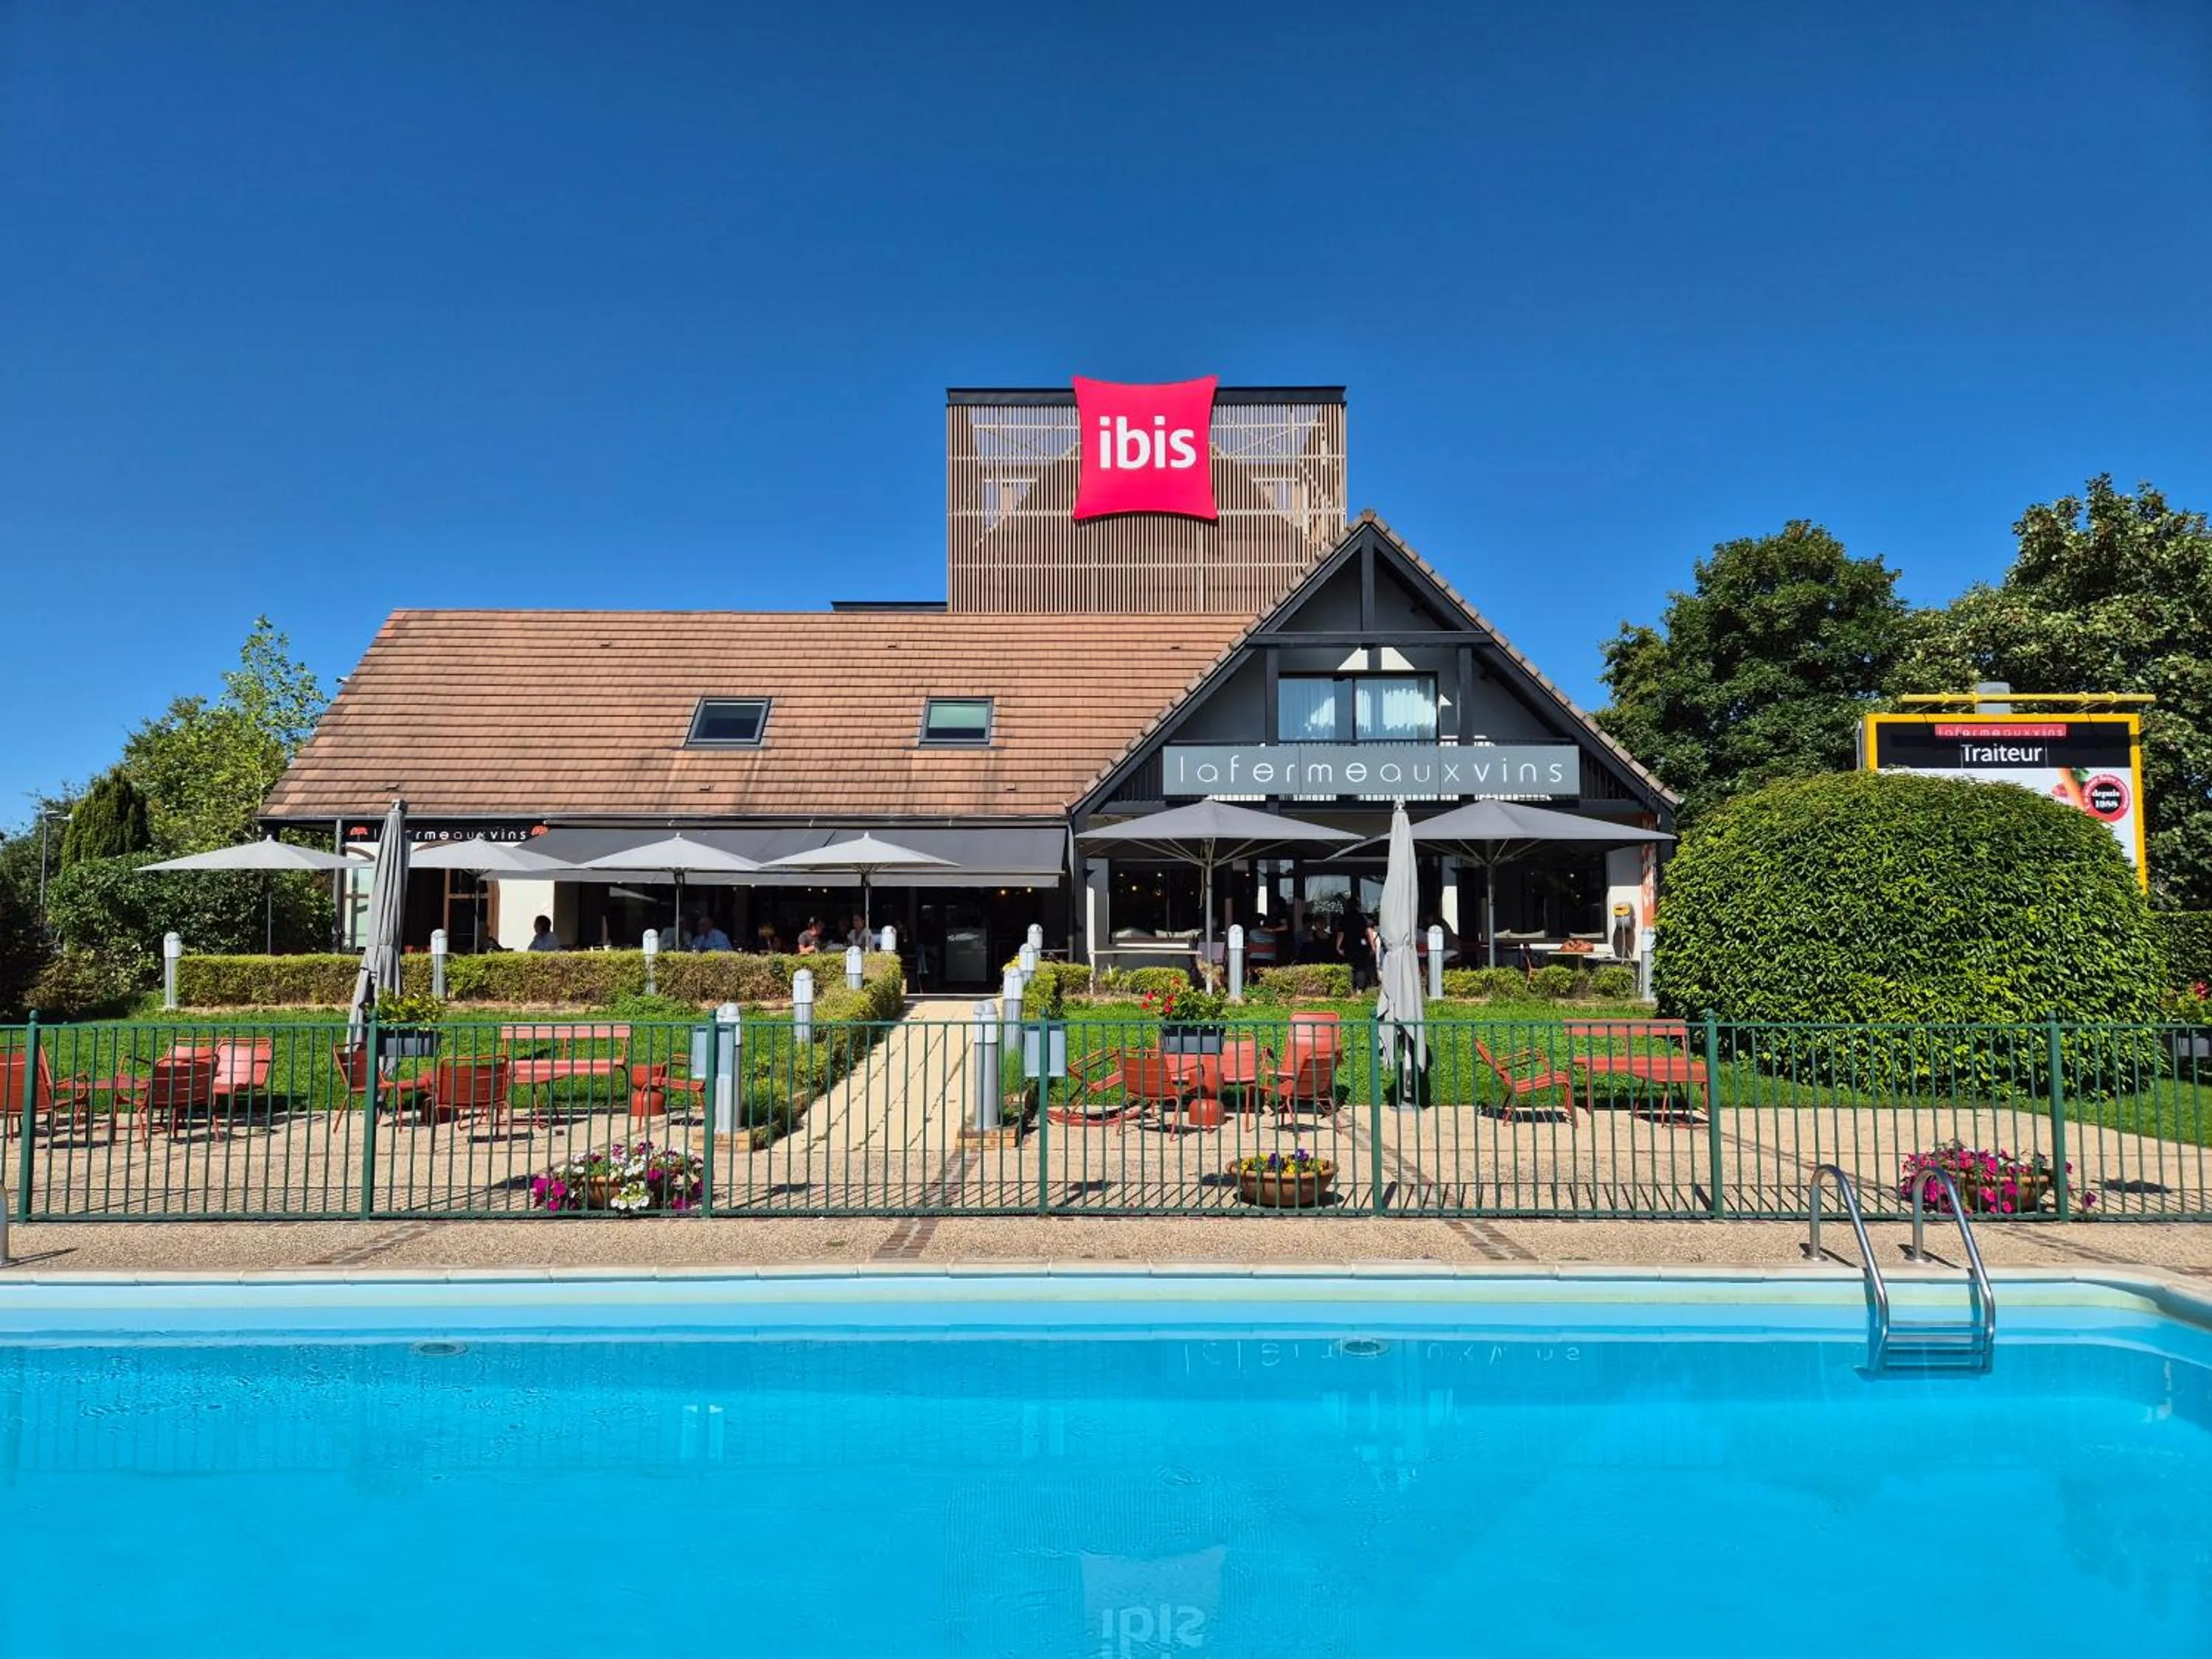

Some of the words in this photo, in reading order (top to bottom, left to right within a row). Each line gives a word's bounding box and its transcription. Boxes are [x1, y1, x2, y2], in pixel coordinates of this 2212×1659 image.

[1099, 415, 1197, 469] ibis
[1961, 743, 2042, 762] Traiteur
[1180, 754, 1562, 783] lafermeauxvins
[374, 828, 526, 840] lrmeauxvins
